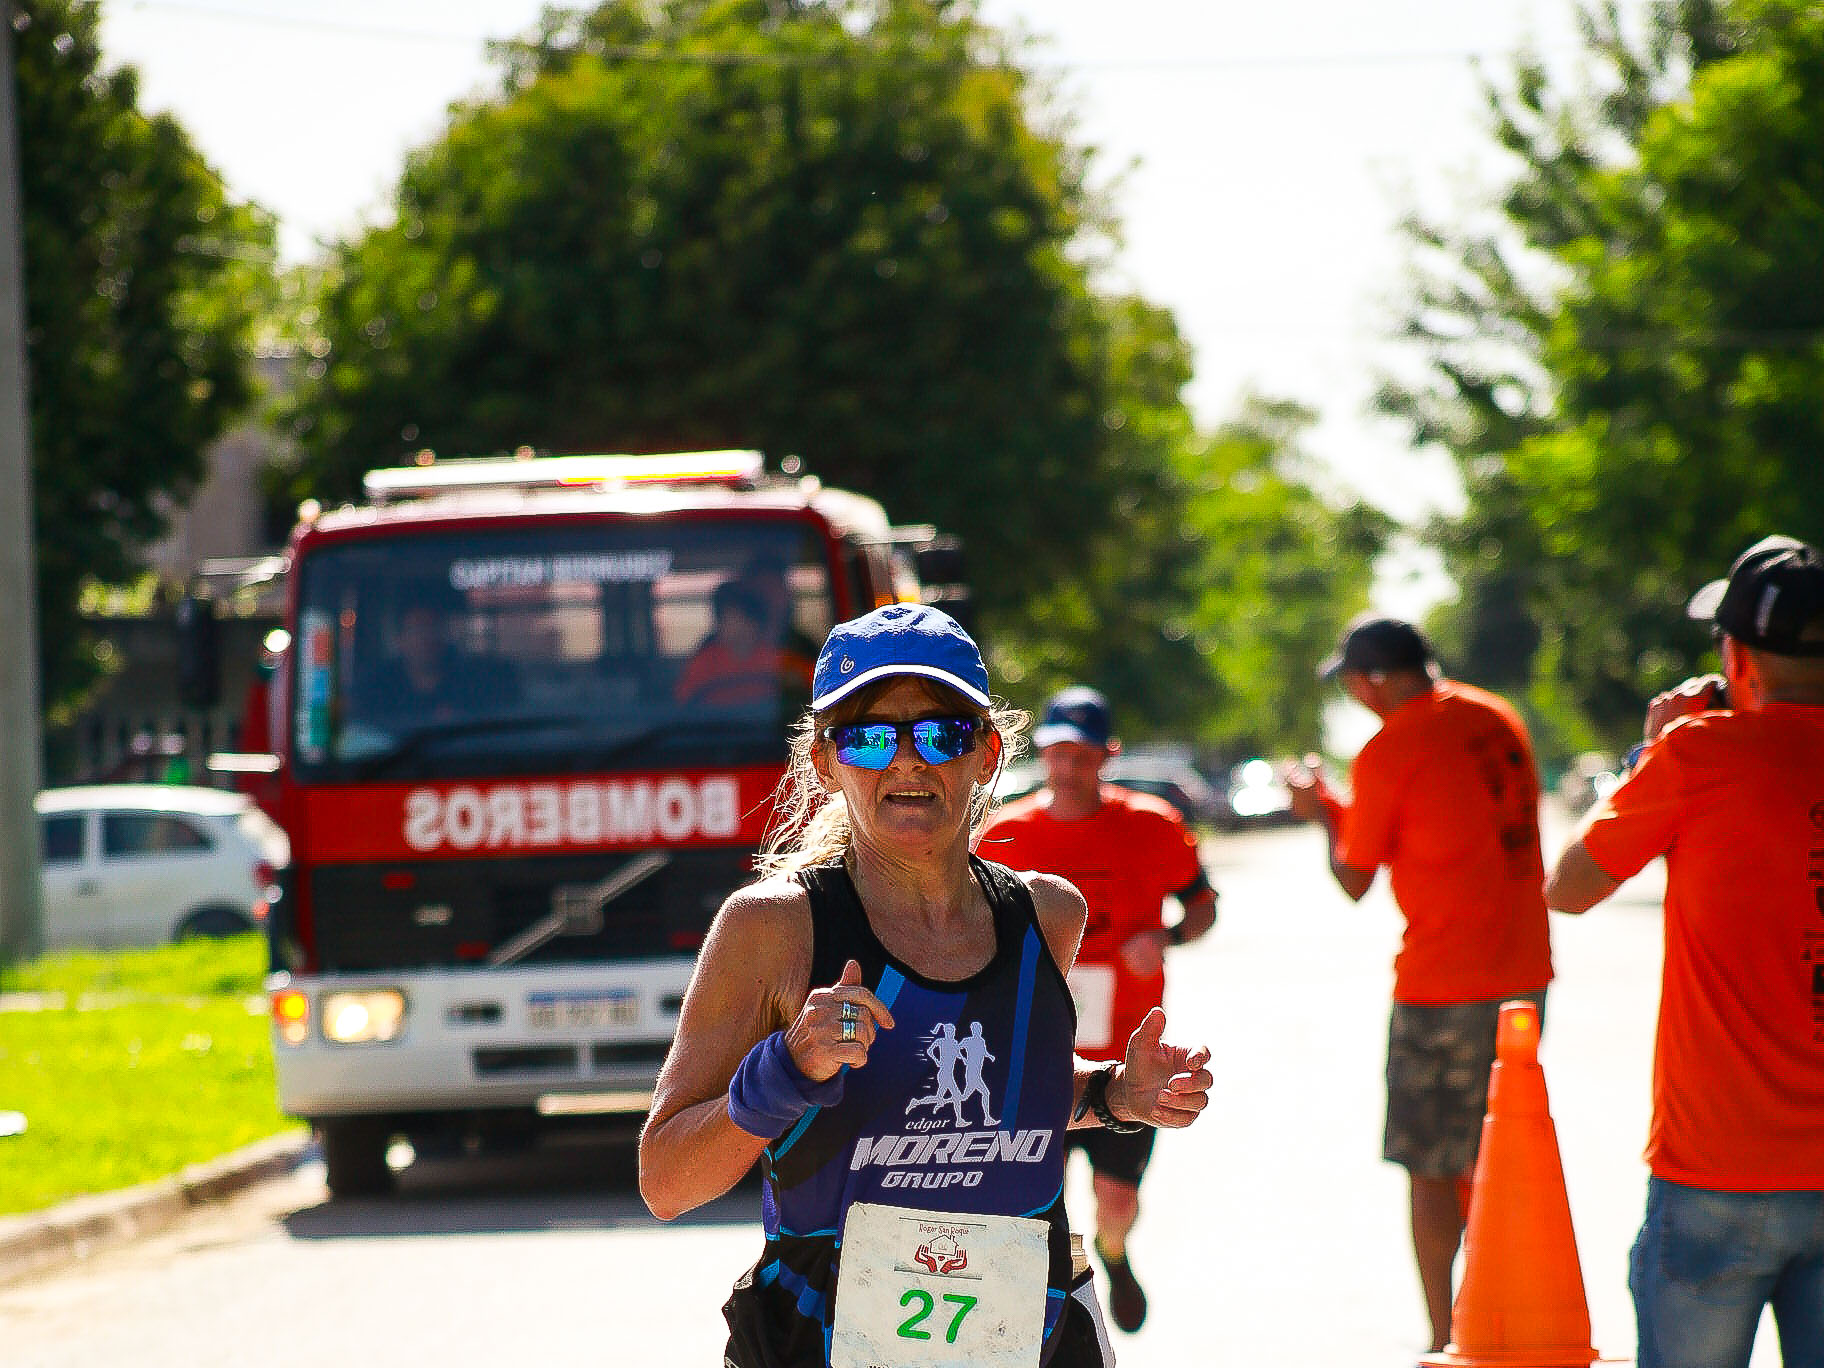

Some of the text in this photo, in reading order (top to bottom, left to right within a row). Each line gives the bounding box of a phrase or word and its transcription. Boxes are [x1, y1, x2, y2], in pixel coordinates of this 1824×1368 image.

[905, 1118, 950, 1133] edgar
[850, 1129, 1053, 1170] MORENO
[881, 1171, 983, 1188] GRUPO
[897, 1290, 977, 1343] 27
